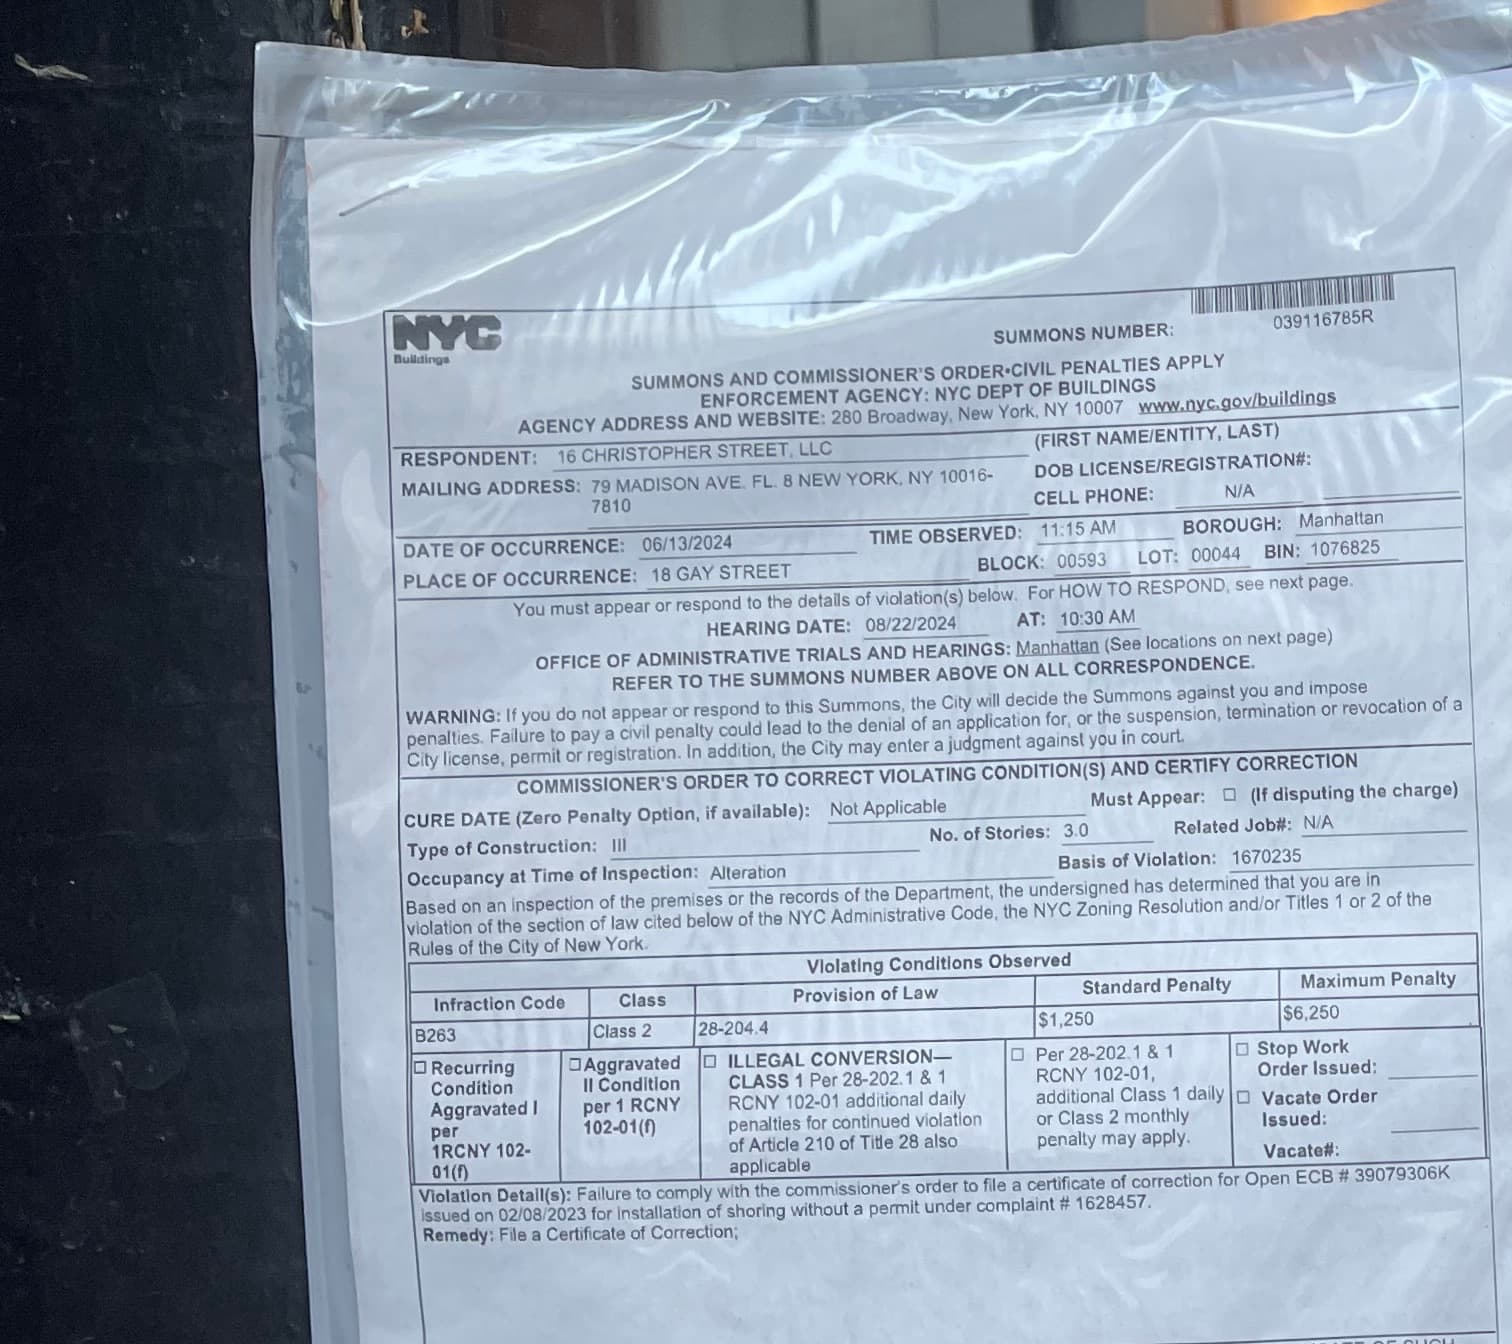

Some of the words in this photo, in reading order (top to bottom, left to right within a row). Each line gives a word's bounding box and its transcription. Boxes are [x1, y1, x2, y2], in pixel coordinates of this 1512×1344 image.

[1273, 308, 1374, 329] 039116785R
[392, 314, 502, 352] NYC
[993, 326, 1085, 344] SUMMONS
[1091, 322, 1173, 340] NUMBER:
[393, 353, 450, 366] Buildings
[631, 372, 723, 390] SUMMONS
[729, 371, 767, 386] AND
[1061, 355, 1160, 375] PENALTIES
[1165, 353, 1224, 370] APPLY
[1034, 431, 1091, 451] (FIRST
[1096, 425, 1221, 445] NAME/ENTITY,
[1227, 422, 1279, 440] LAST)
[400, 450, 536, 467] RESPONDENT:
[558, 449, 576, 464] 16
[581, 444, 712, 463] CHRISTOPHER
[799, 440, 832, 456] LLC
[1034, 463, 1073, 478] DOB
[1079, 451, 1310, 476] LICENSE/REGISTRATION#:
[1033, 490, 1079, 505] CELL
[1085, 486, 1153, 504] PHONE:
[1225, 483, 1255, 498] N/A
[868, 529, 912, 544] TIME
[918, 524, 1021, 544] OBSERVED:
[1041, 520, 1085, 537] 11:15
[1089, 519, 1115, 535] AM
[1183, 515, 1281, 535] BOROUGH:
[1299, 511, 1383, 528] Manhattan
[403, 542, 453, 558] DATE
[459, 542, 485, 557] OF
[490, 537, 624, 557] OCCURRENCE:
[642, 533, 732, 552] 06/13/2024
[1137, 548, 1178, 565] LOT:
[1191, 546, 1240, 563] 00044
[1264, 543, 1299, 559] BIN:
[1311, 538, 1380, 557] 1076825
[977, 553, 1043, 572] BLOCK:
[1056, 551, 1106, 568] 00593
[403, 573, 467, 589] PLACE
[472, 572, 496, 587] OF
[503, 568, 636, 586] OCCURRENCE:
[651, 566, 670, 582] 18
[676, 564, 714, 581] GAY
[719, 563, 791, 580] STREET
[706, 620, 790, 636] HEARING
[796, 618, 850, 634] DATE:
[865, 615, 956, 632] 08/22/2024
[1082, 977, 1160, 995] Standard
[1166, 976, 1231, 994] Penalty
[1300, 972, 1385, 988] Maximum
[1390, 969, 1456, 989] Penalty
[433, 996, 515, 1012] Infraction
[520, 994, 565, 1009] Code
[618, 992, 666, 1007] Class
[1038, 1010, 1094, 1029] $1,250
[1283, 1004, 1339, 1023] $6,250
[415, 1028, 456, 1043] B263
[593, 1023, 636, 1039] Class
[641, 1022, 651, 1037] 2
[698, 1020, 768, 1036] 28-204.4
[422, 1227, 493, 1246] Remedy:
[499, 1226, 527, 1241] File
[531, 1230, 541, 1241] a
[546, 1225, 625, 1241] Certificate
[630, 1225, 646, 1240] of
